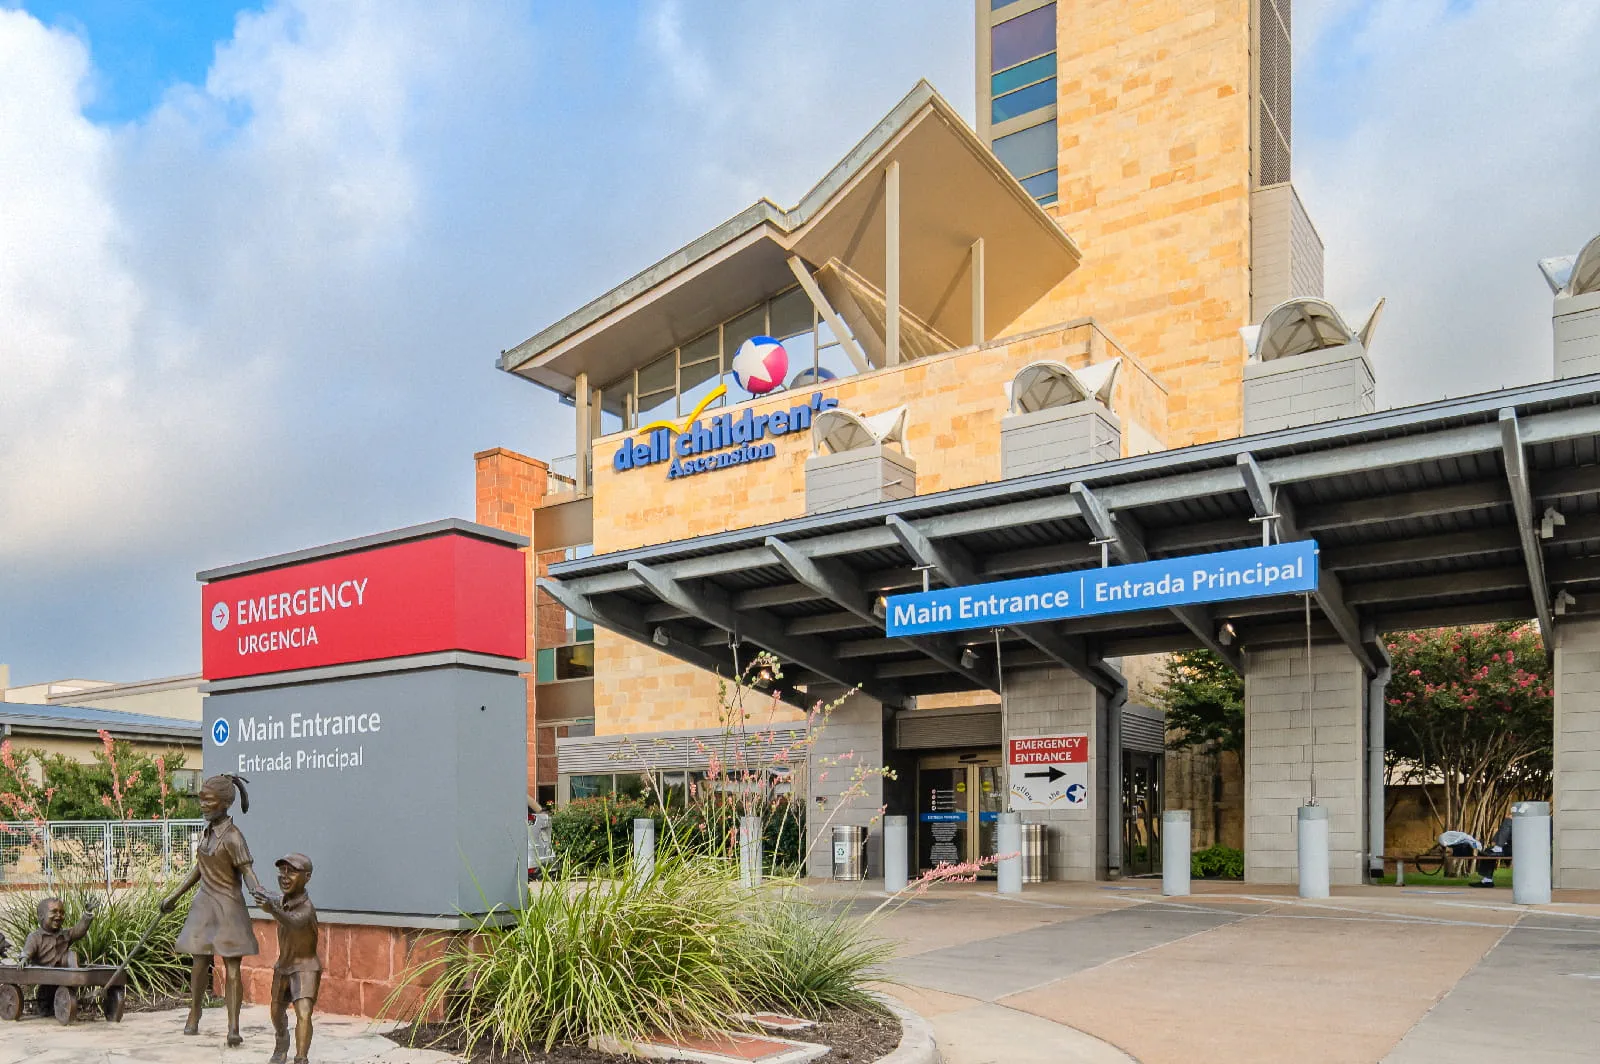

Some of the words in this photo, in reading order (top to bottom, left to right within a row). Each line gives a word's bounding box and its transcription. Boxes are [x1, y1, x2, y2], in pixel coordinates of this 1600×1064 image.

[613, 428, 670, 471] dell
[667, 442, 776, 479] Ascension
[237, 578, 369, 625] EMERGENCY
[893, 596, 952, 627] Main
[959, 588, 1069, 619] Entrance
[1095, 573, 1185, 602] Entrada
[1193, 557, 1303, 591] Principal
[238, 626, 318, 656] URGENCIA
[238, 714, 284, 742] Main
[290, 711, 381, 739] Entrance
[238, 751, 292, 773] Entrada
[296, 746, 364, 772] Principal
[1015, 738, 1081, 750] EMERGENCY
[1015, 751, 1072, 763] ENTRANCE
